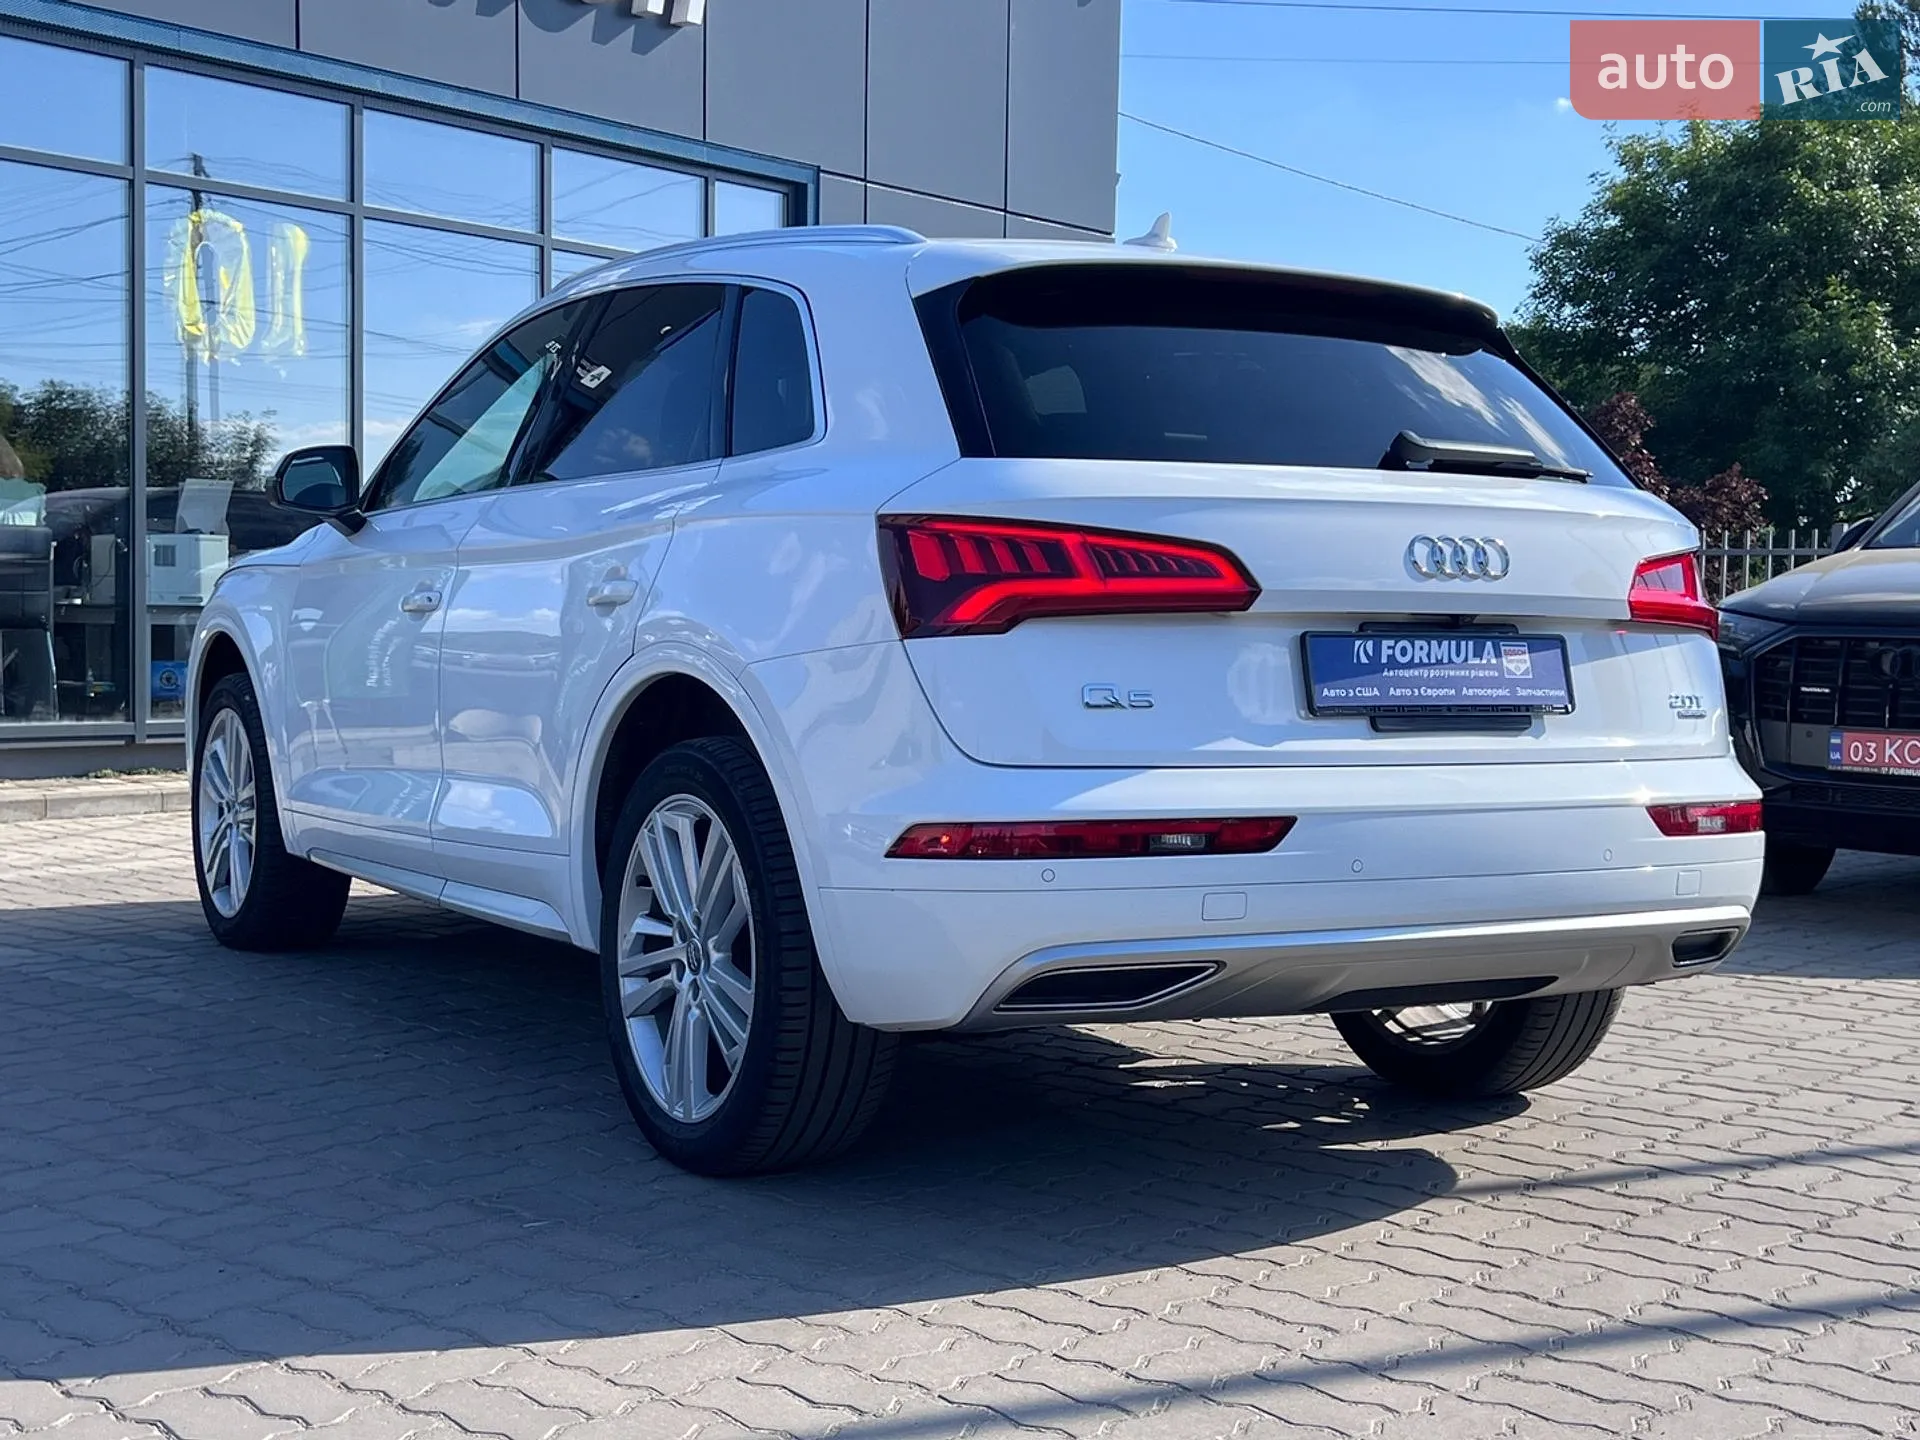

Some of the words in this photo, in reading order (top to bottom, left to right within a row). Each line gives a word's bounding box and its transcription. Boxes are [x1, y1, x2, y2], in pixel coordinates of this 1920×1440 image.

[1381, 639, 1497, 664] FORMULA
[1382, 667, 1429, 678] Автоцентр
[1429, 668, 1470, 679] розумних
[1470, 667, 1499, 679] рішень
[1082, 683, 1154, 709] Q5
[1322, 687, 1346, 697] Авто
[1348, 689, 1354, 697] з
[1355, 687, 1380, 697] США
[1389, 687, 1411, 697] Авто
[1413, 689, 1419, 697] з
[1420, 687, 1456, 698] Європи
[1462, 687, 1511, 698] Автосервіс
[1516, 687, 1566, 697] Запчастини
[1830, 751, 1841, 760] UA
[1850, 741, 1877, 763] 03
